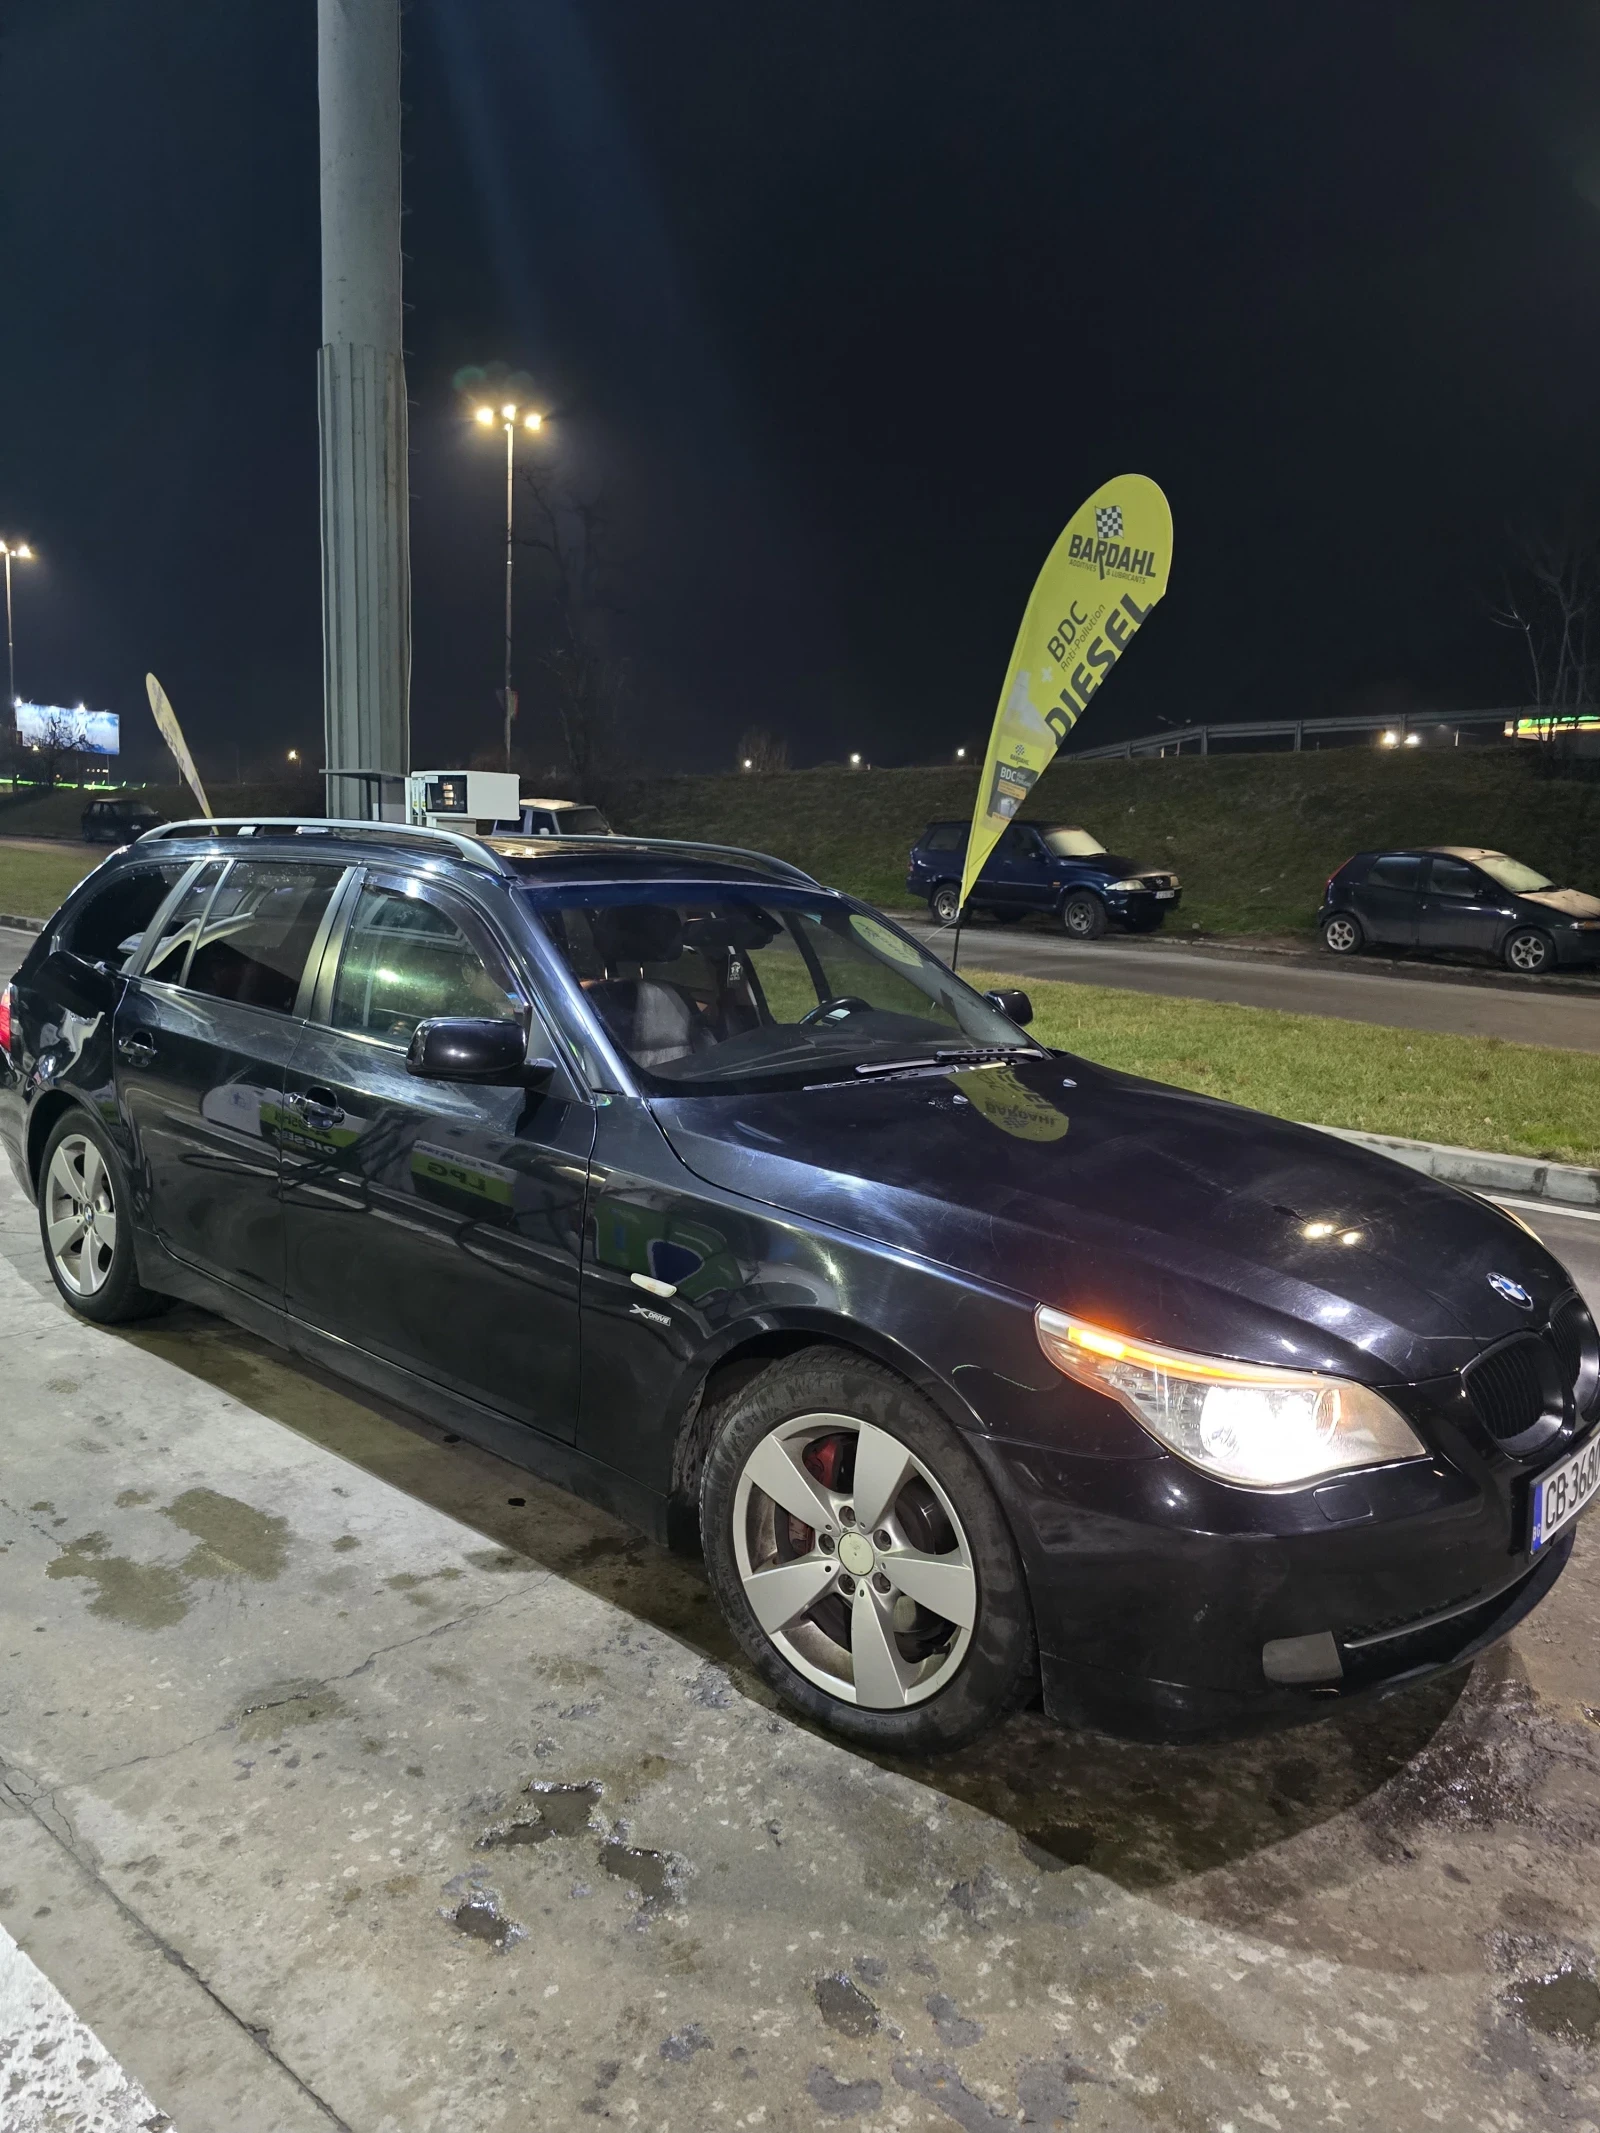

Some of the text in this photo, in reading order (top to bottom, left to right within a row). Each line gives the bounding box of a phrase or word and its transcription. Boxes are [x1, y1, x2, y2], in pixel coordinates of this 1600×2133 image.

[1068, 534, 1156, 580] BARDAHL
[1069, 559, 1097, 573] ADDITIVES
[1111, 571, 1146, 584] LUBRICANTS
[1047, 600, 1088, 663] BDC
[1060, 603, 1106, 672] Anti-Pollution
[1044, 593, 1153, 748] DIESEL
[1000, 766, 1017, 782] BDC
[1532, 1523, 1541, 1541] BG
